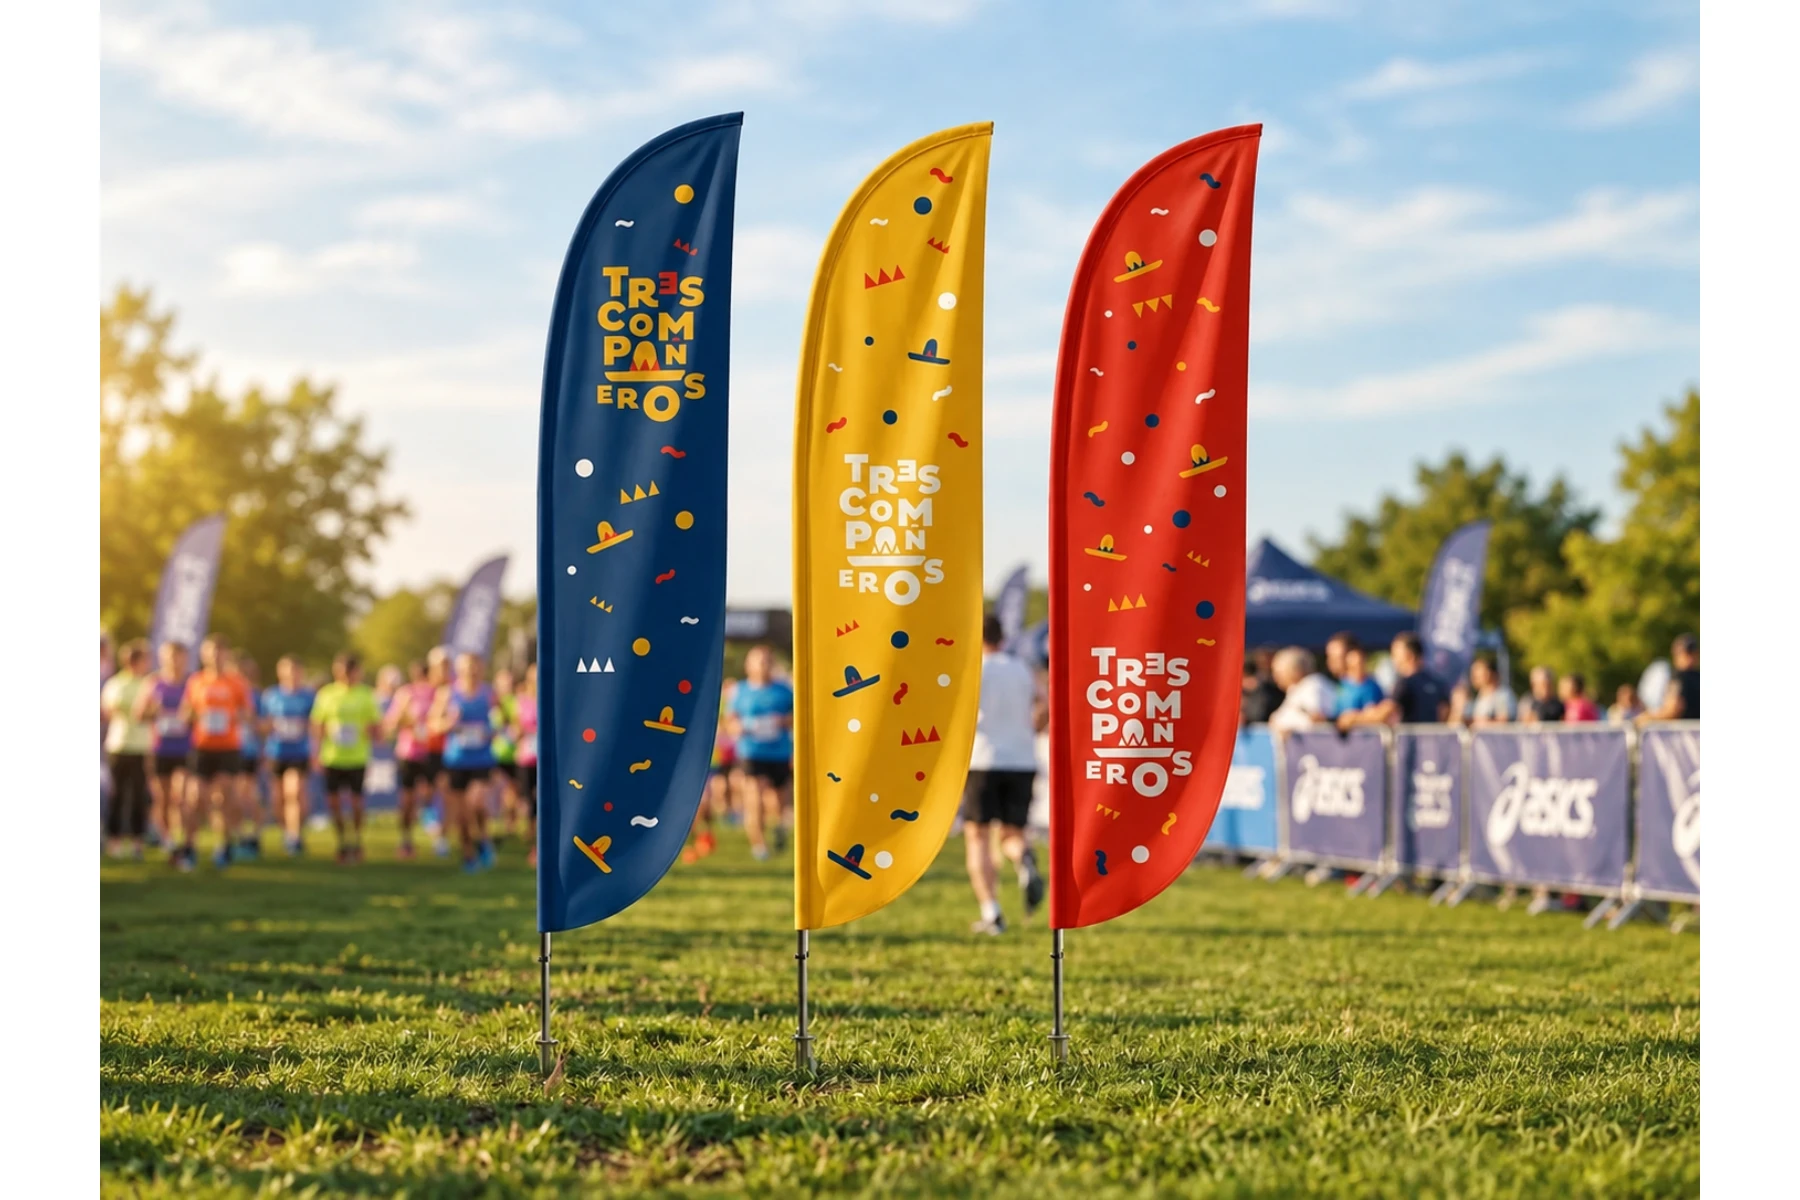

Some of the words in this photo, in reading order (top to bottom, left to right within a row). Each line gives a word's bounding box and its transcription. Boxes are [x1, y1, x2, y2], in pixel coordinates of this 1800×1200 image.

[602, 266, 705, 308] TRES
[597, 300, 694, 341] COM
[596, 372, 706, 423] EROS
[844, 453, 941, 494] TRES
[839, 487, 933, 527] COM
[838, 558, 945, 606] EROS
[1091, 647, 1190, 687] TRES
[1086, 679, 1181, 719] COM
[1086, 750, 1193, 798] EROS
